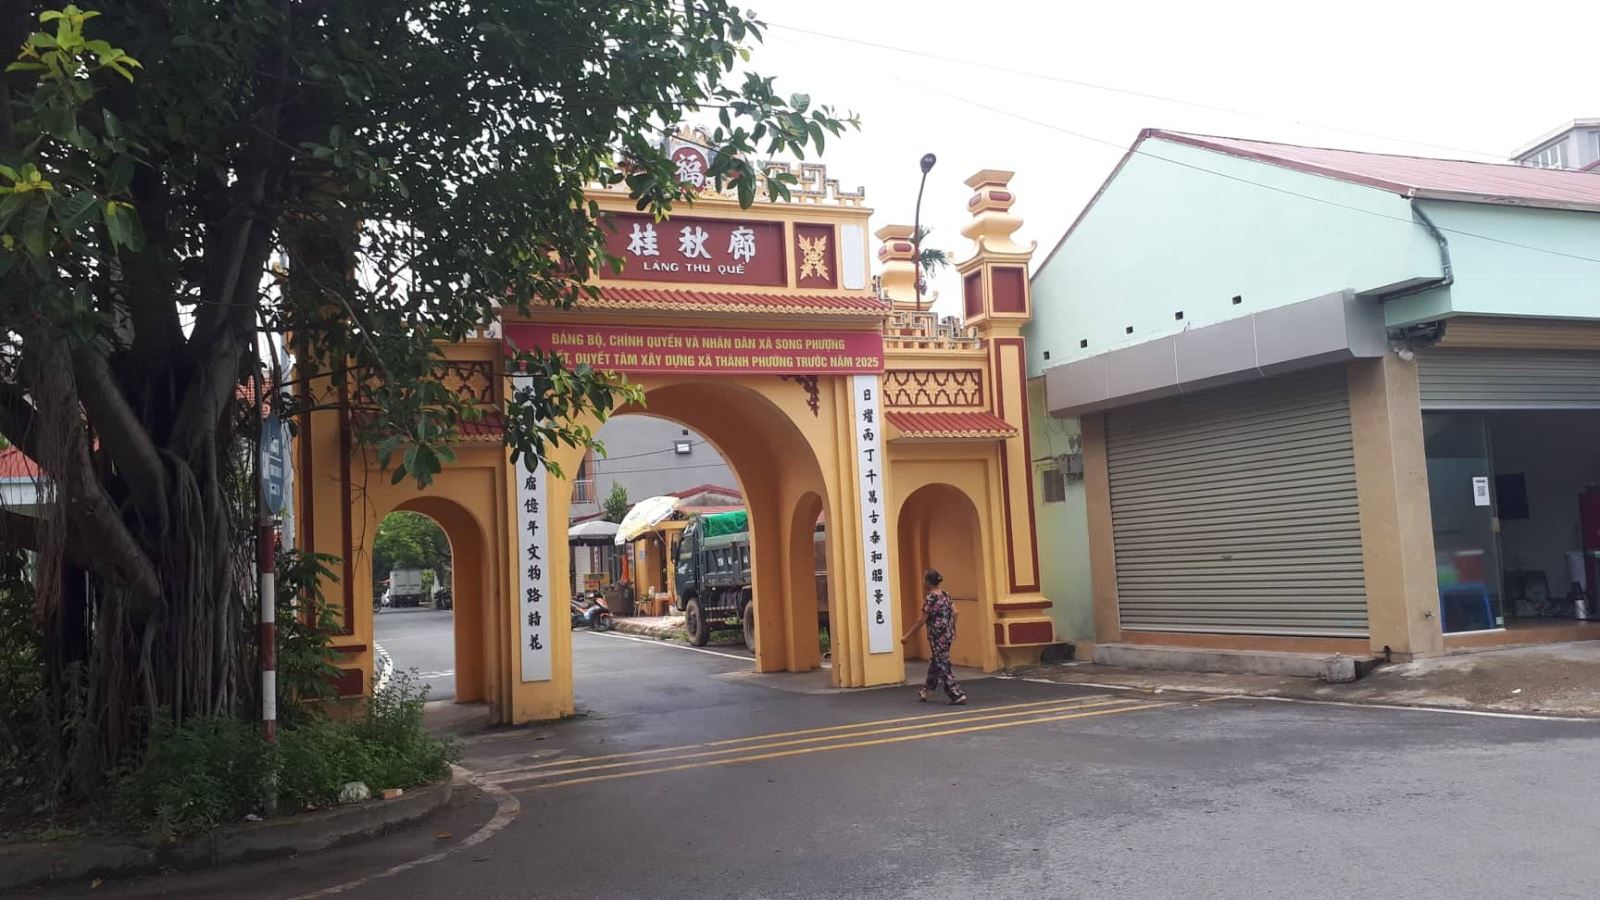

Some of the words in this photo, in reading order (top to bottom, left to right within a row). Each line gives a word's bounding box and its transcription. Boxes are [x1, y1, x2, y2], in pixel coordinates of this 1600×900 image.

[643, 260, 679, 272] LÀNG
[685, 263, 711, 273] THU
[551, 331, 584, 345] ĐẢNG
[587, 332, 606, 348] BỘ,
[609, 333, 643, 347] CHÍNH
[685, 335, 700, 348] VÀ
[702, 335, 731, 349] NHÂN
[735, 336, 756, 349] DÂN
[759, 336, 773, 349] XÃ
[775, 338, 803, 350] SONG
[805, 338, 845, 352] PHƯỢNG
[575, 350, 611, 365] QUYẾT
[613, 351, 638, 365] TÂM
[641, 351, 662, 366] XÂY
[665, 353, 695, 368] DỰNG
[698, 353, 713, 367] XÃ
[715, 353, 749, 367] THÀNH
[752, 353, 793, 368] PHƯỜNG
[796, 354, 828, 368] TRƯỚC
[830, 355, 853, 368] NĂM
[855, 356, 879, 368] 2025
